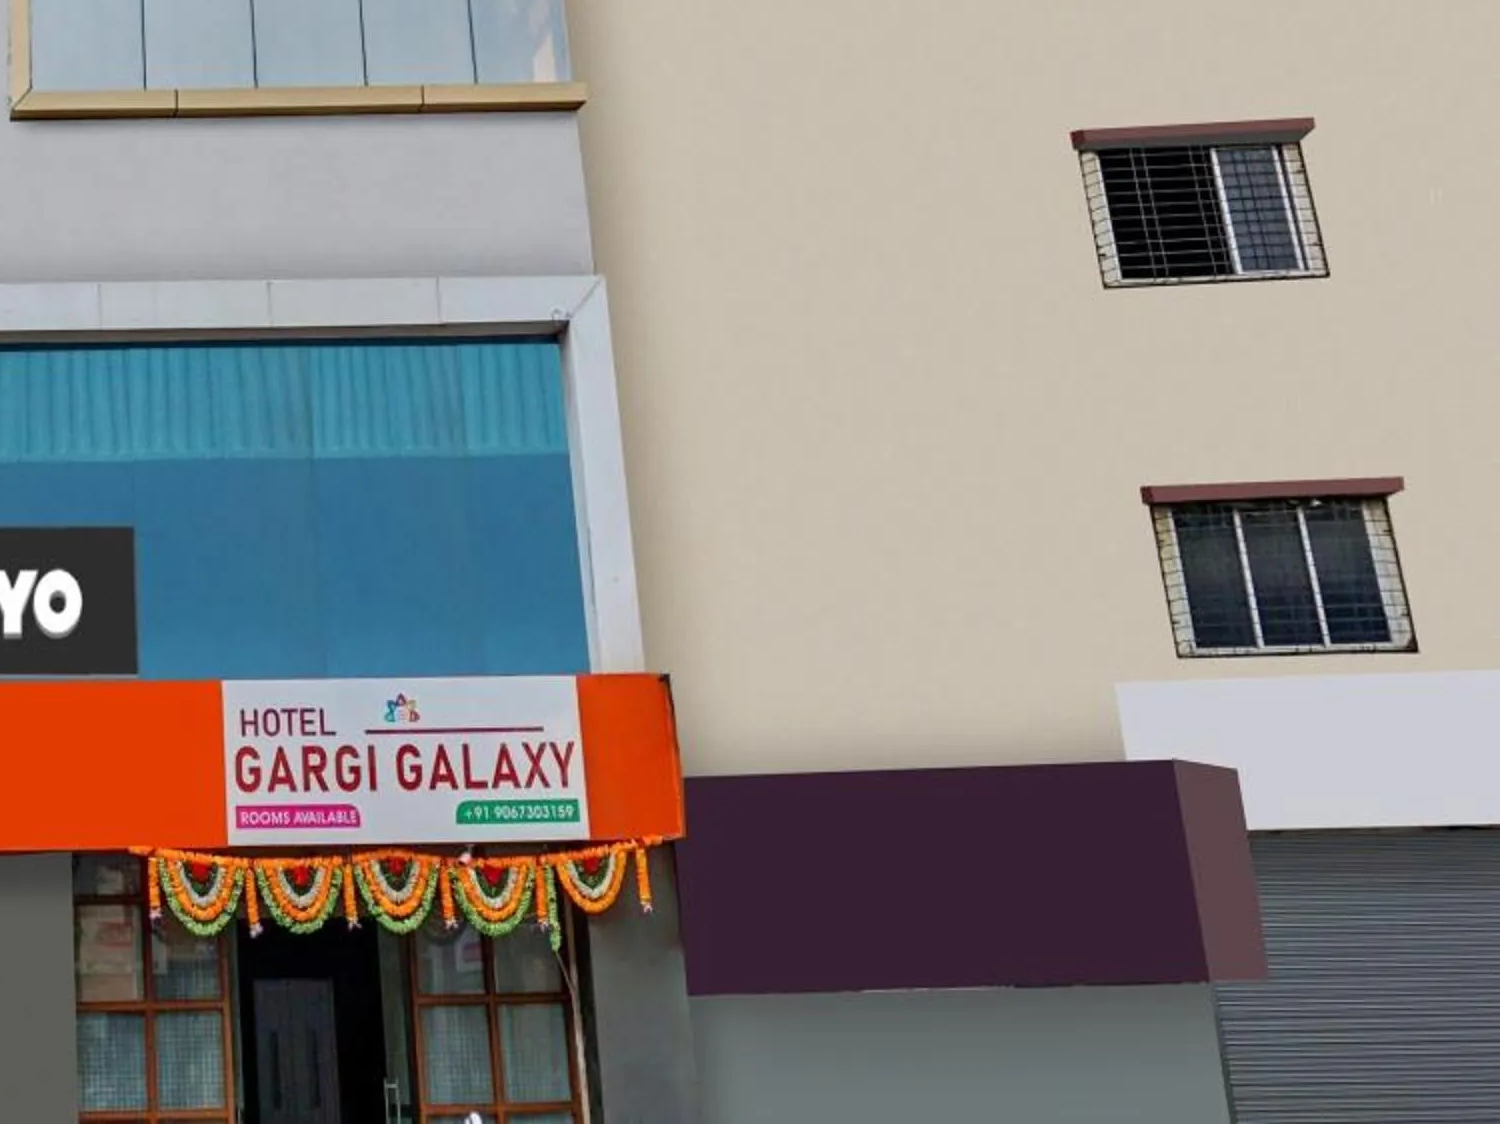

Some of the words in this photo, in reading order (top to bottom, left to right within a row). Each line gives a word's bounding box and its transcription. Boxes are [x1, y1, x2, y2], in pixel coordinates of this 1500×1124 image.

[240, 708, 337, 737] HOTEL
[235, 744, 377, 793] GARGI
[395, 741, 575, 791] GALAXY
[241, 810, 291, 826] ROOMS
[293, 809, 357, 825] AVAILABLE
[463, 805, 489, 820] +91
